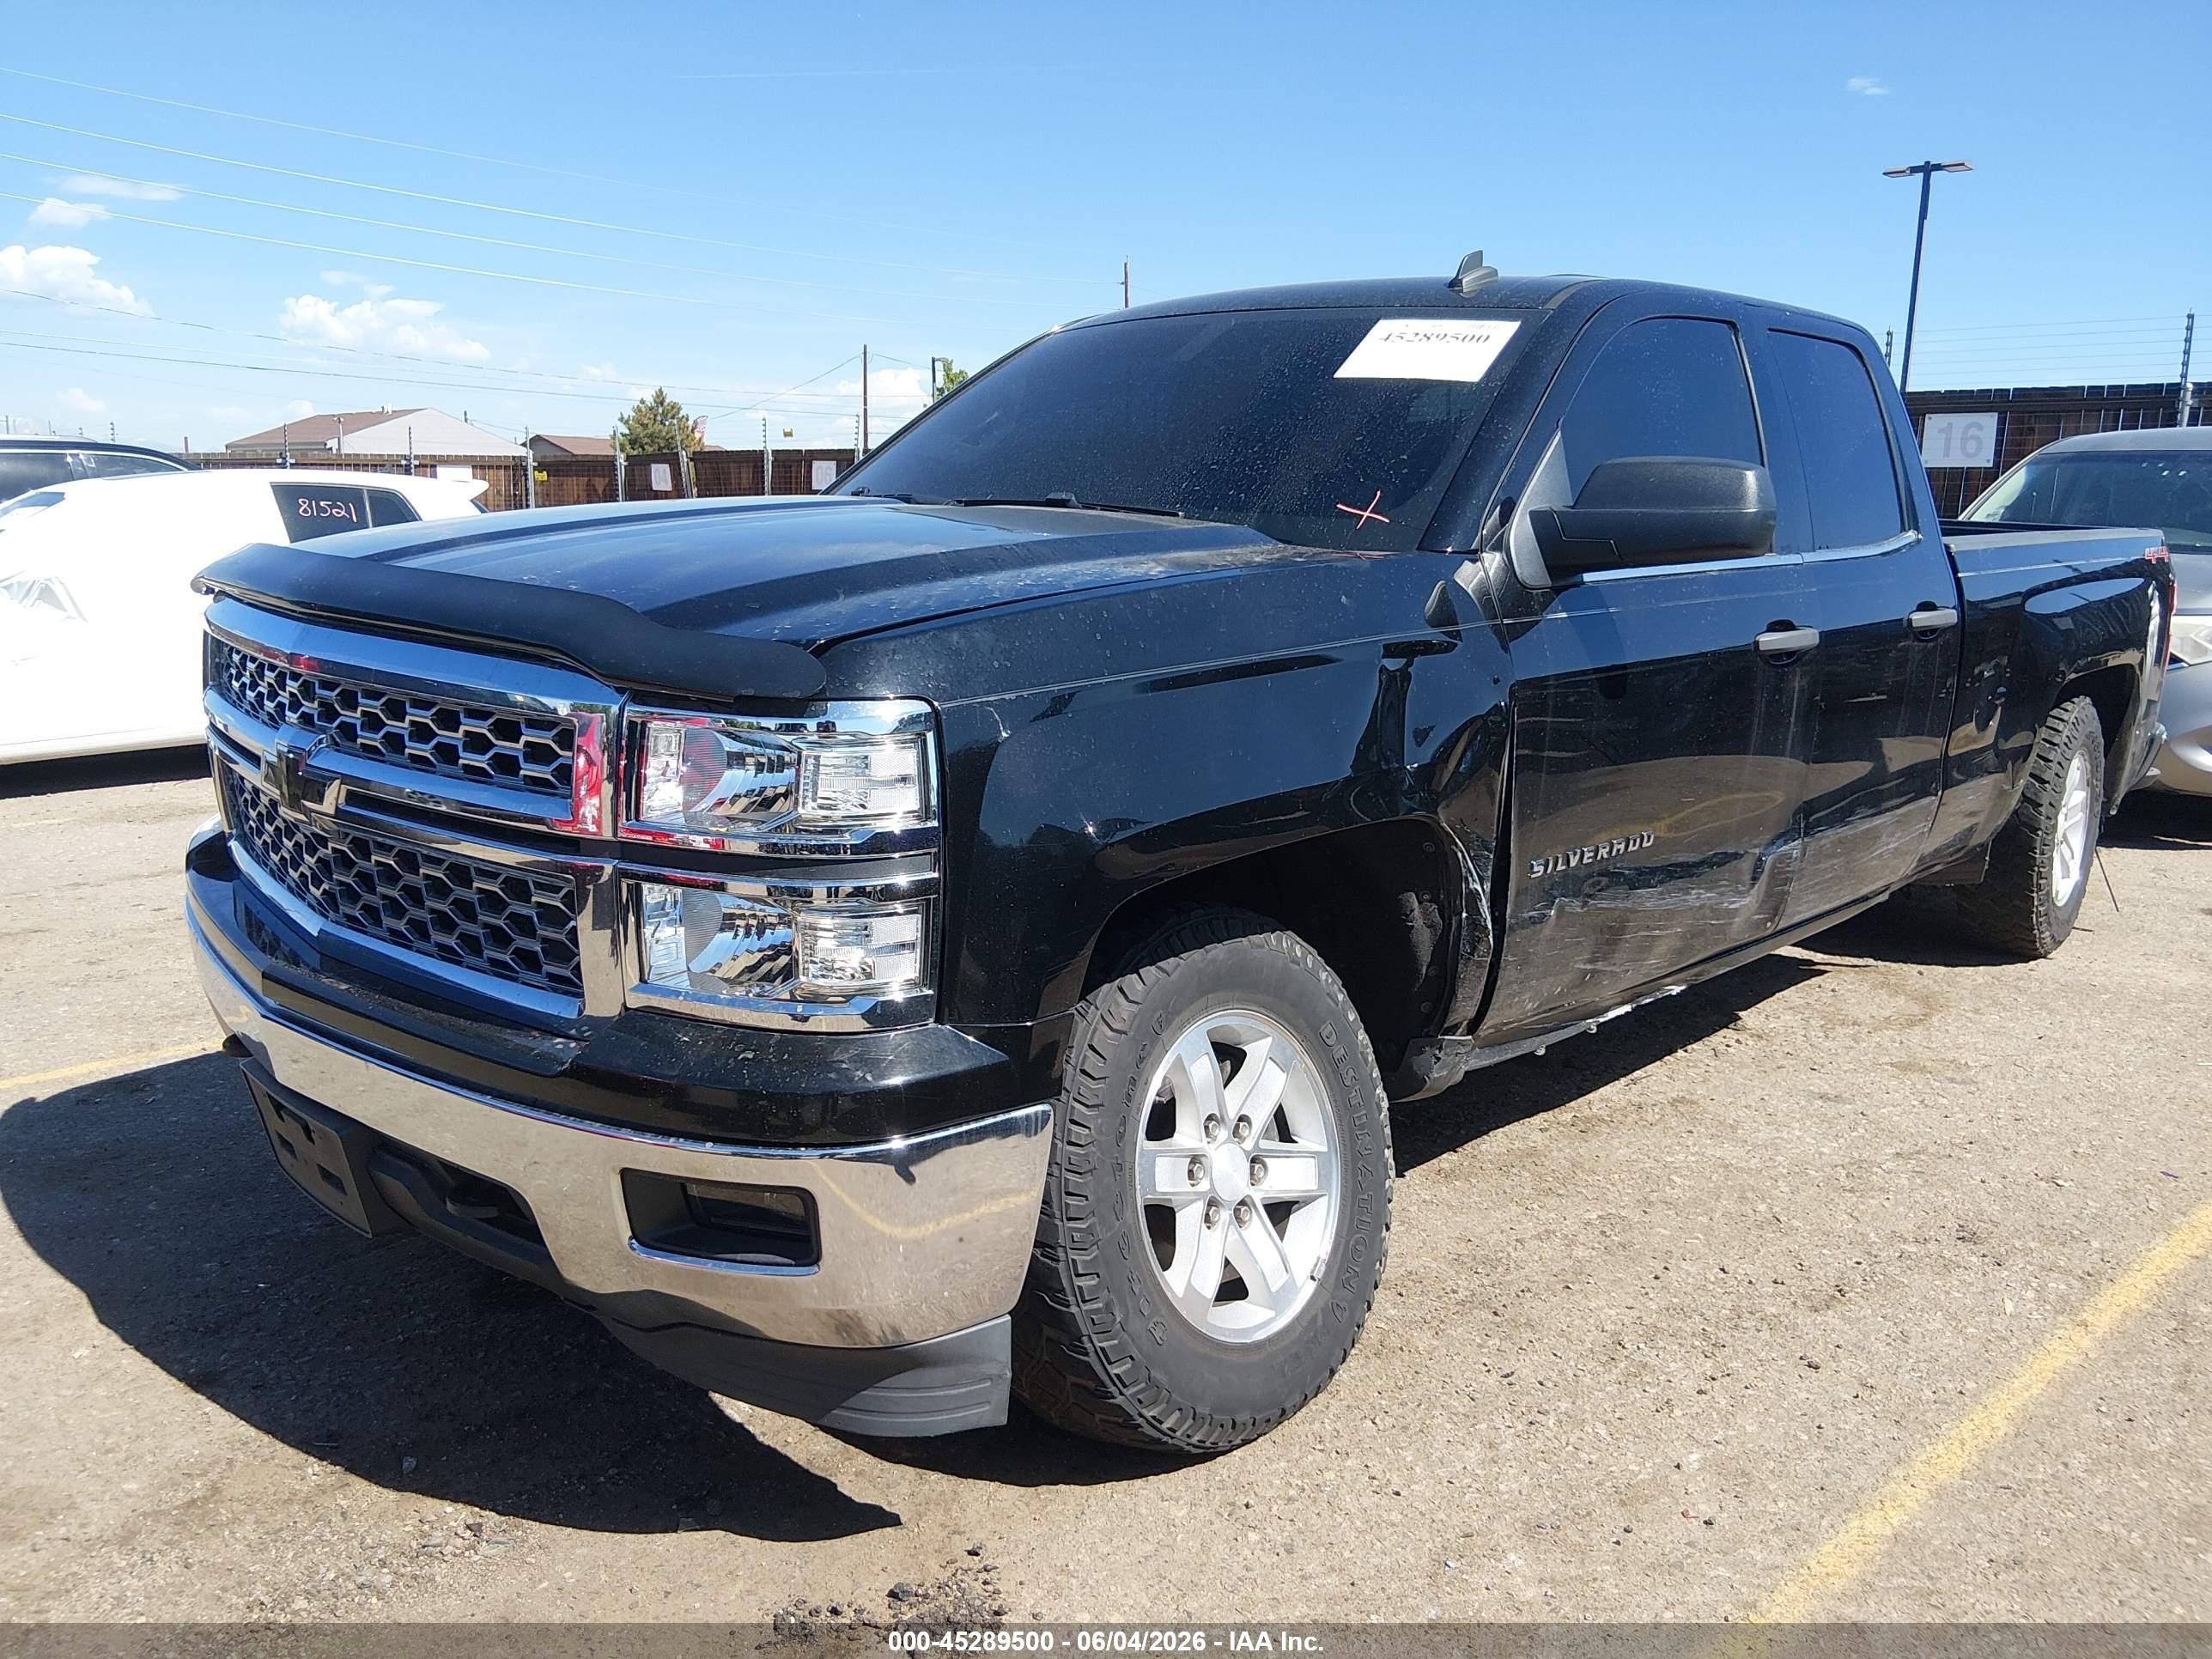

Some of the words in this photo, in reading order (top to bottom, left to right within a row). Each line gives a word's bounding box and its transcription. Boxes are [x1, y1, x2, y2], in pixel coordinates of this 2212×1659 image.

[1379, 332, 1491, 343] 45289500
[1937, 422, 1984, 459] 16
[298, 498, 357, 523] 81521
[1527, 830, 1655, 878] SILVERADO
[1318, 1021, 1374, 1297] DESTINATION
